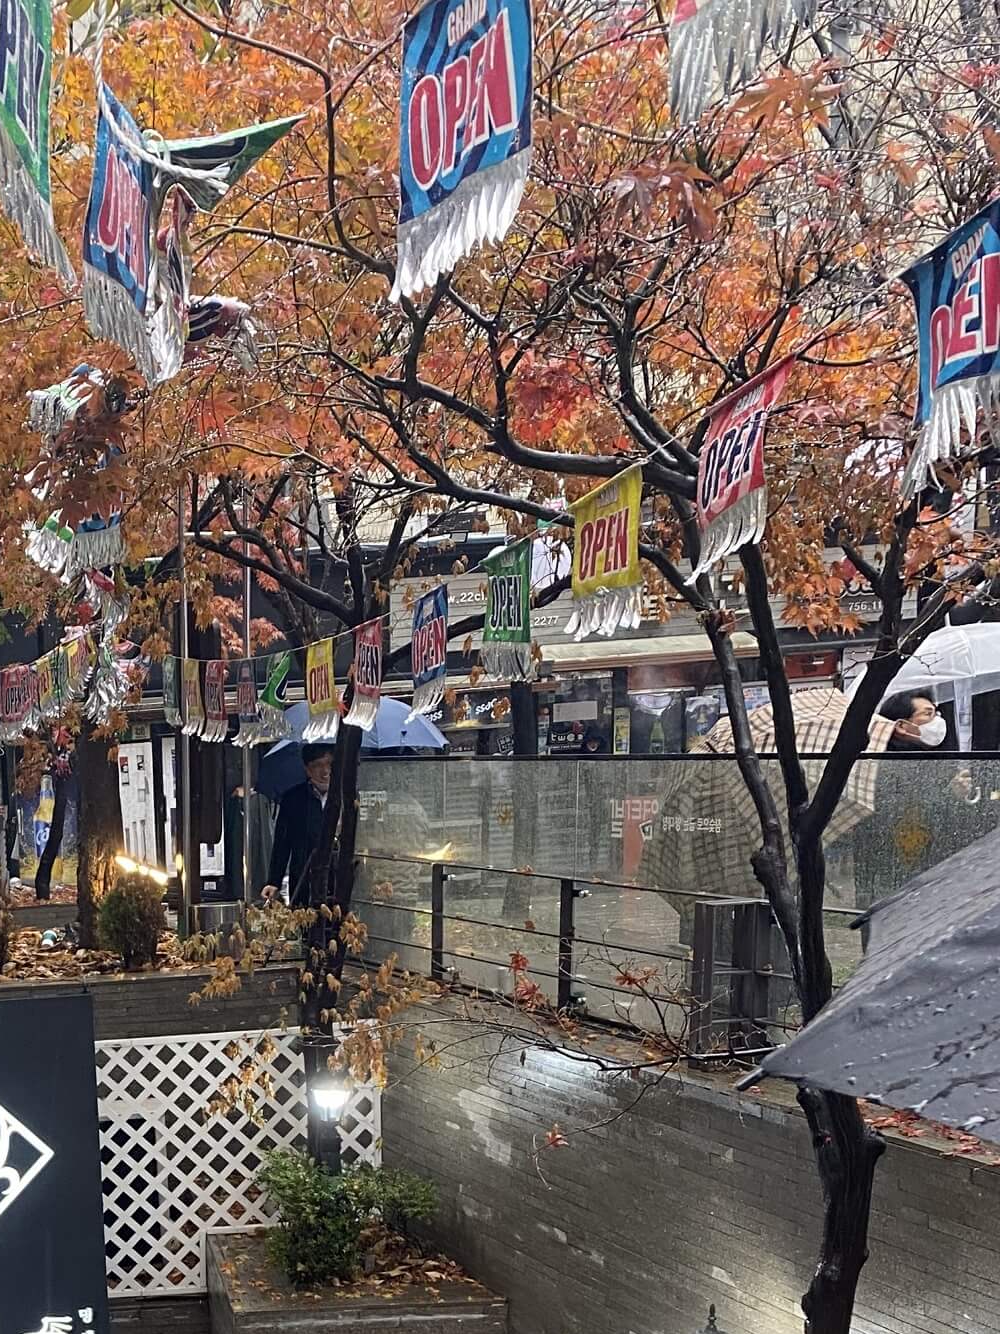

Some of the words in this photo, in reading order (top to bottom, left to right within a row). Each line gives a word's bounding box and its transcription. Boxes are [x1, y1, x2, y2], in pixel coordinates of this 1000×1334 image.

[408, 7, 520, 192] OPEN
[701, 409, 767, 513] OPEN
[579, 505, 630, 583] OPEN
[488, 574, 524, 632] OPEN
[354, 639, 381, 690] OPEN
[411, 615, 447, 679] OPEN
[309, 662, 331, 706] OPEN
